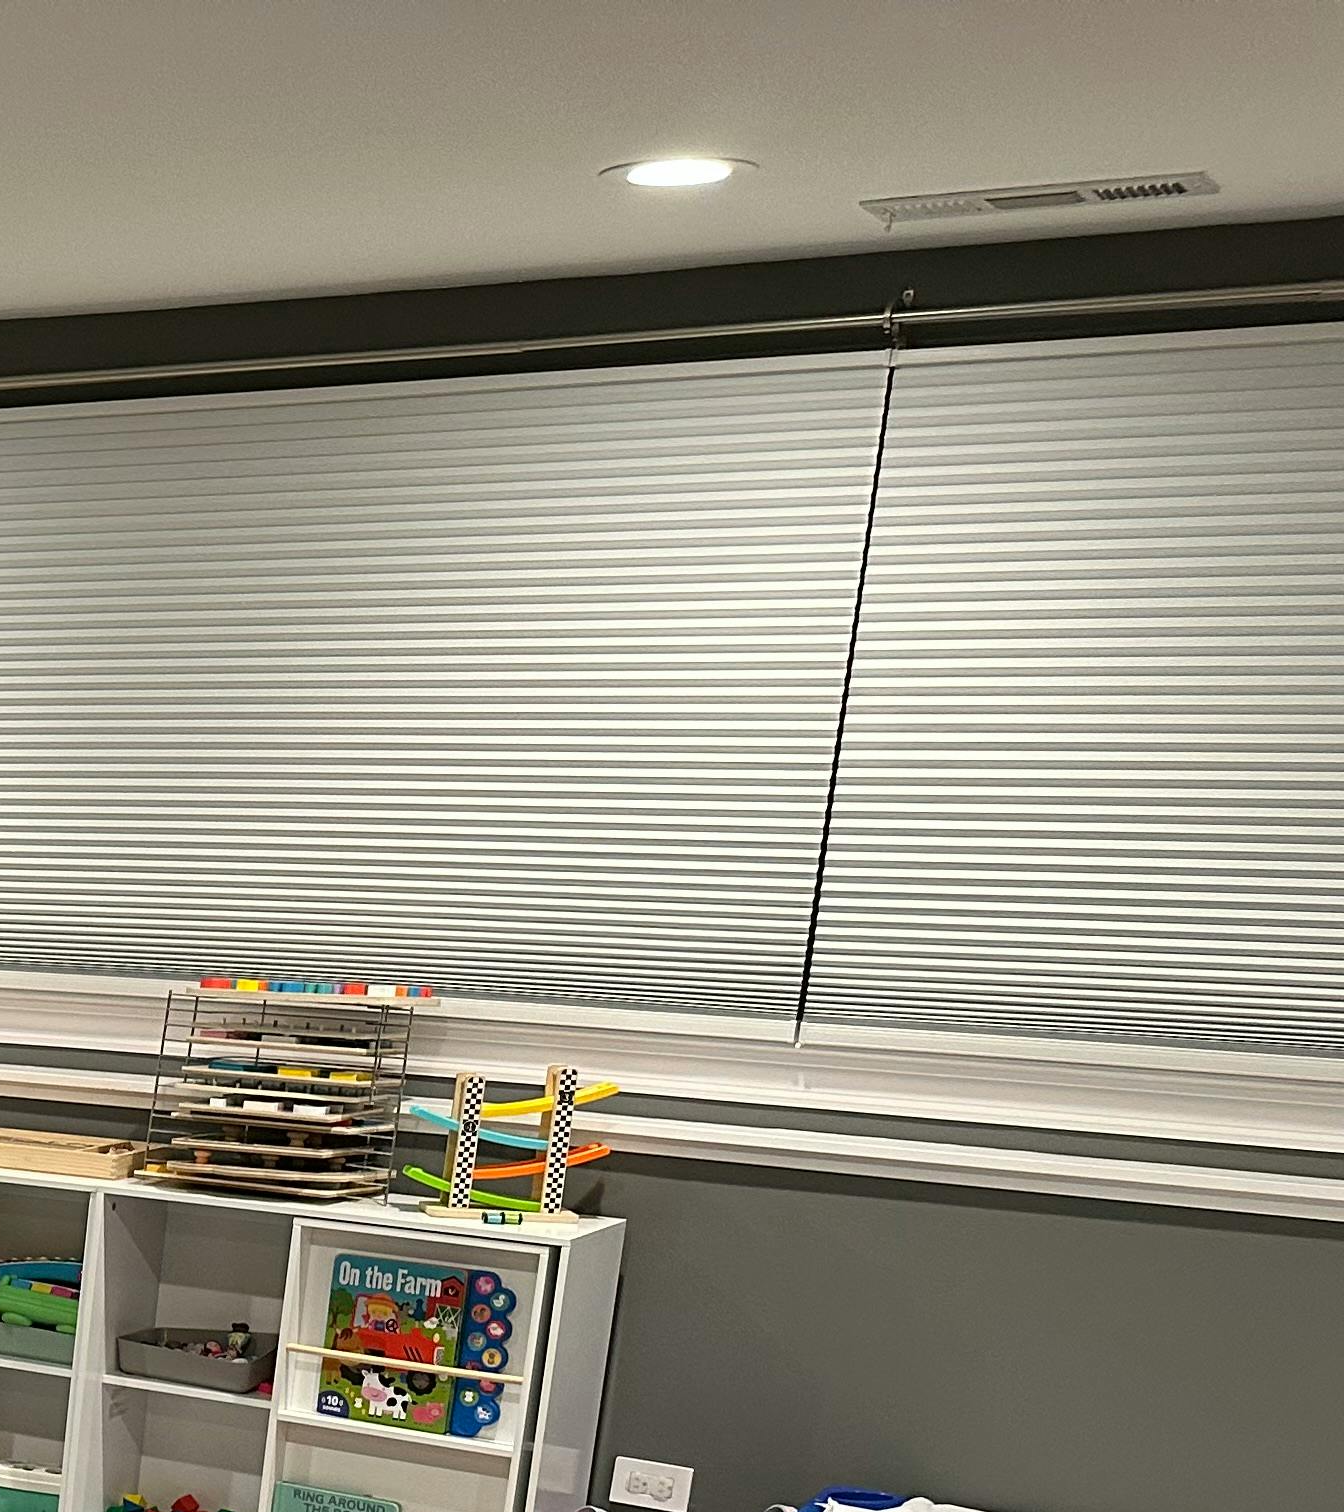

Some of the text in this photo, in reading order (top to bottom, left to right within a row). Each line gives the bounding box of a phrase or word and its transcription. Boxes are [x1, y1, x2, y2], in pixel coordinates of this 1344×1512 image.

[338, 1261, 442, 1298] On the Farm
[326, 1395, 339, 1407] 10
[293, 1489, 325, 1504] RING
